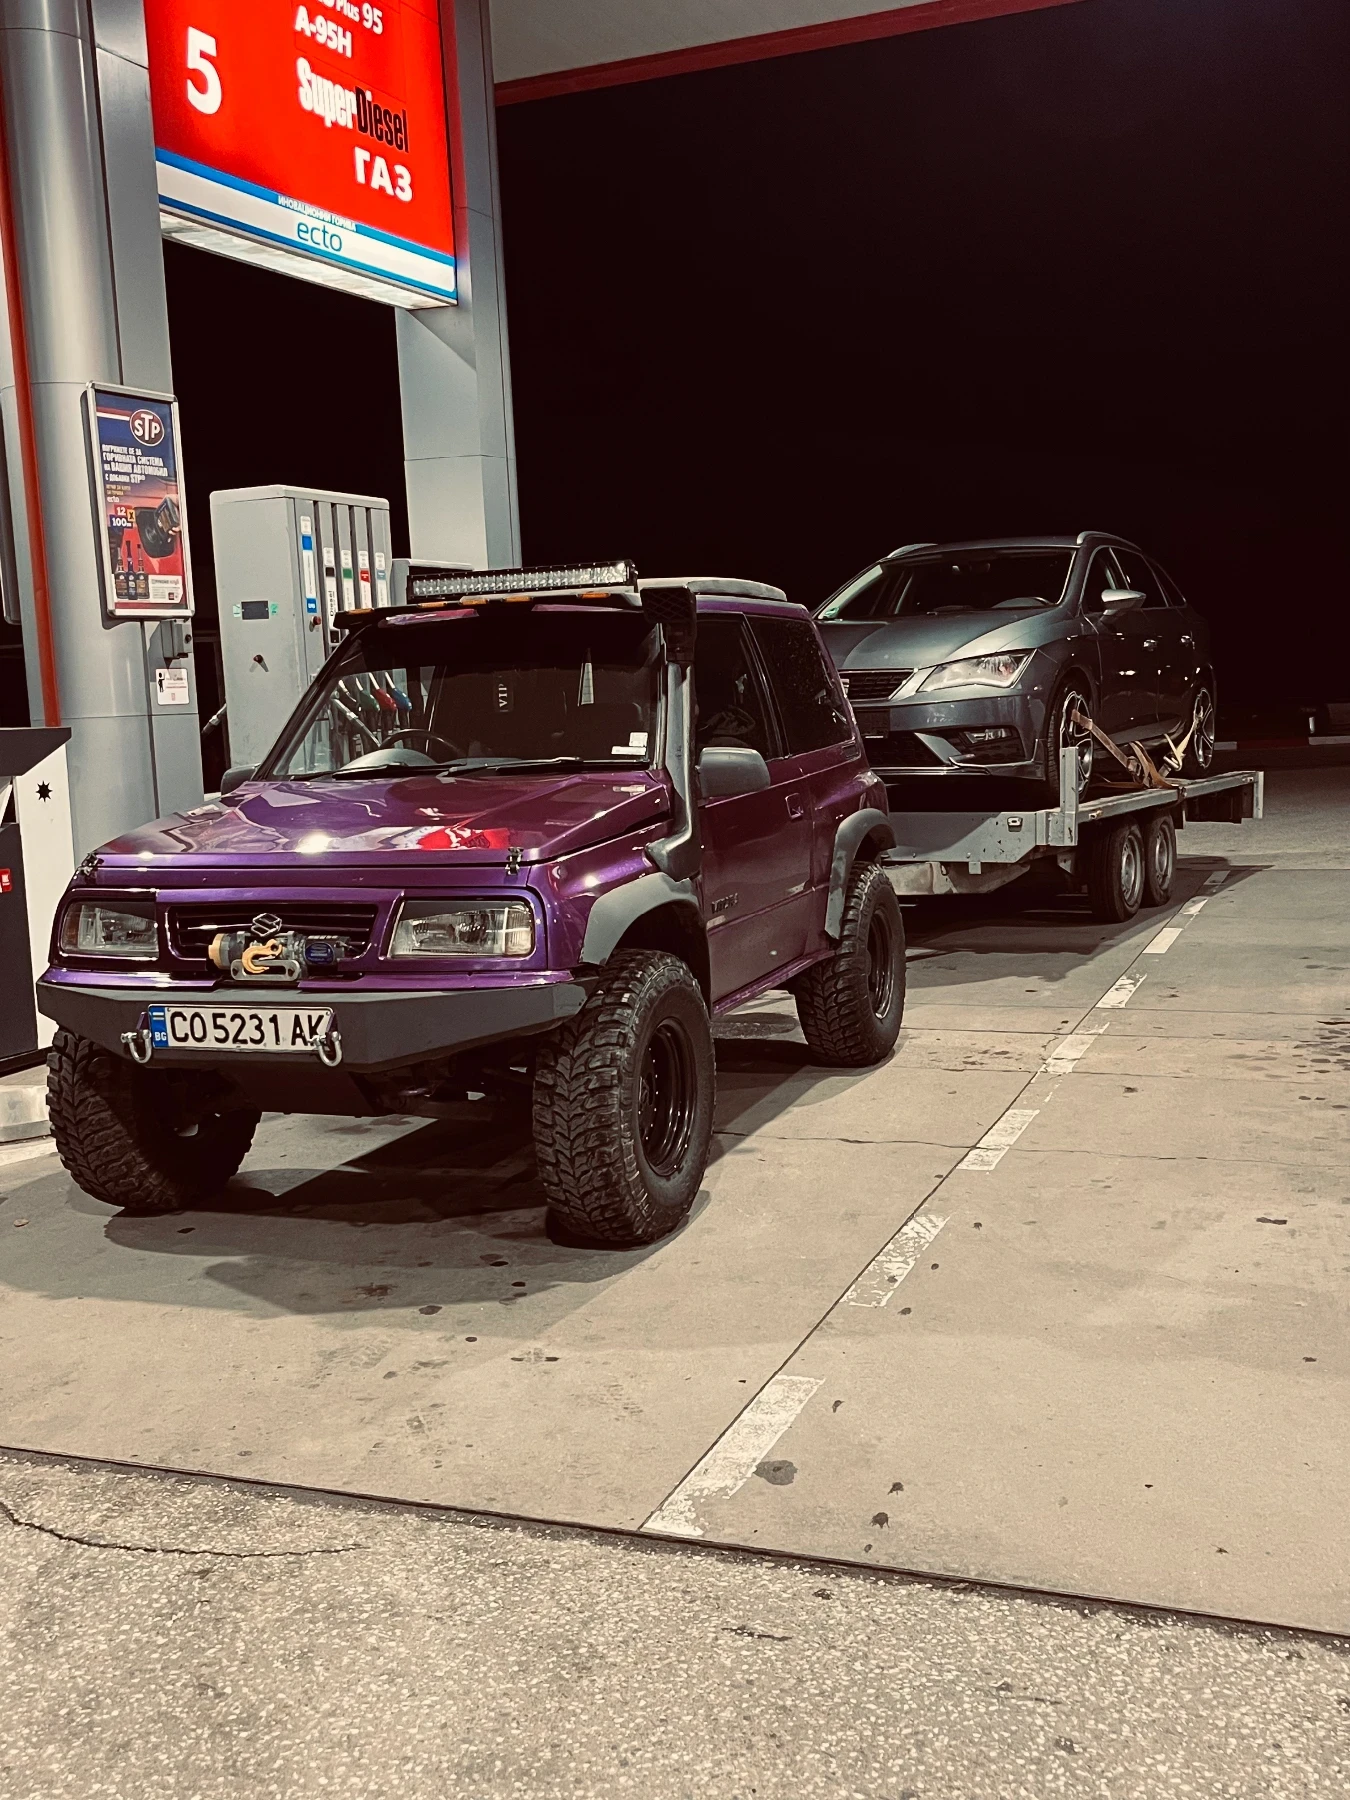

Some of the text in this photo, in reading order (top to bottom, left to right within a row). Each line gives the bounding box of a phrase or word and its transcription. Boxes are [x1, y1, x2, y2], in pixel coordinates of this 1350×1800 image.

[362, 3, 383, 35] 95
[186, 26, 222, 115] 5
[354, 146, 413, 202] ГАЗ
[297, 221, 342, 252] ecto
[134, 413, 161, 441] STP
[116, 506, 127, 516] 12
[154, 1031, 167, 1041] BG
[170, 1011, 325, 1046] CO 5231 AK
